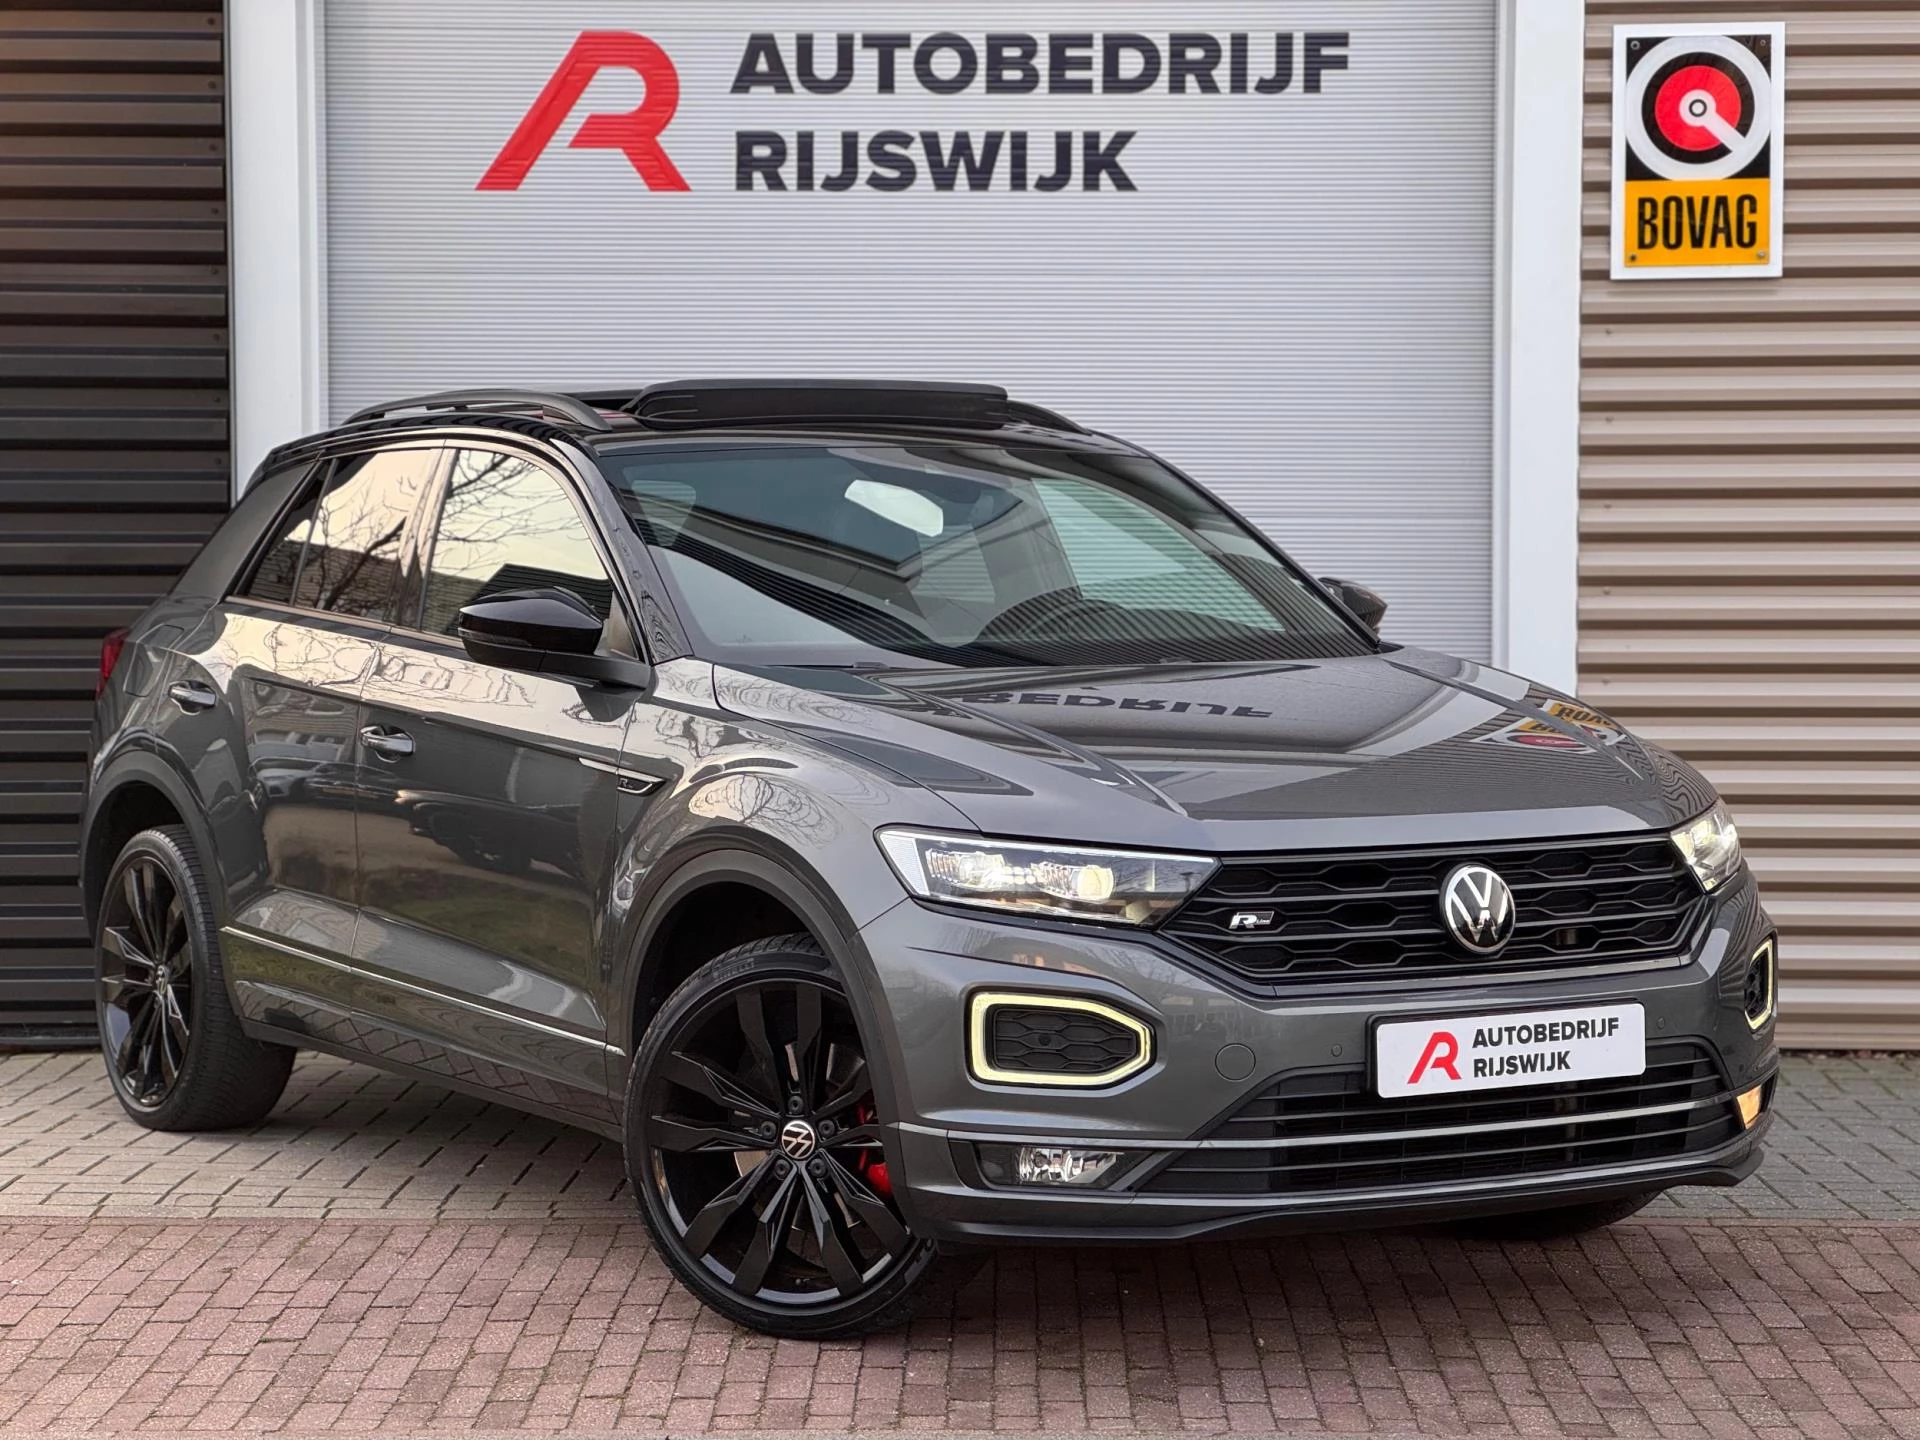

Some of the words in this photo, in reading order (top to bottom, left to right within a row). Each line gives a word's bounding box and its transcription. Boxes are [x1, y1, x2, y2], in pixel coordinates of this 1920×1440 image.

[730, 32, 1349, 95] AUTOBEDRIJF
[735, 130, 1137, 192] RIJSWIJK
[1637, 194, 1757, 250] BOVAG
[1472, 1017, 1619, 1049] AUTOBEDRIJF
[1473, 1051, 1571, 1078] RIJSWIJK
